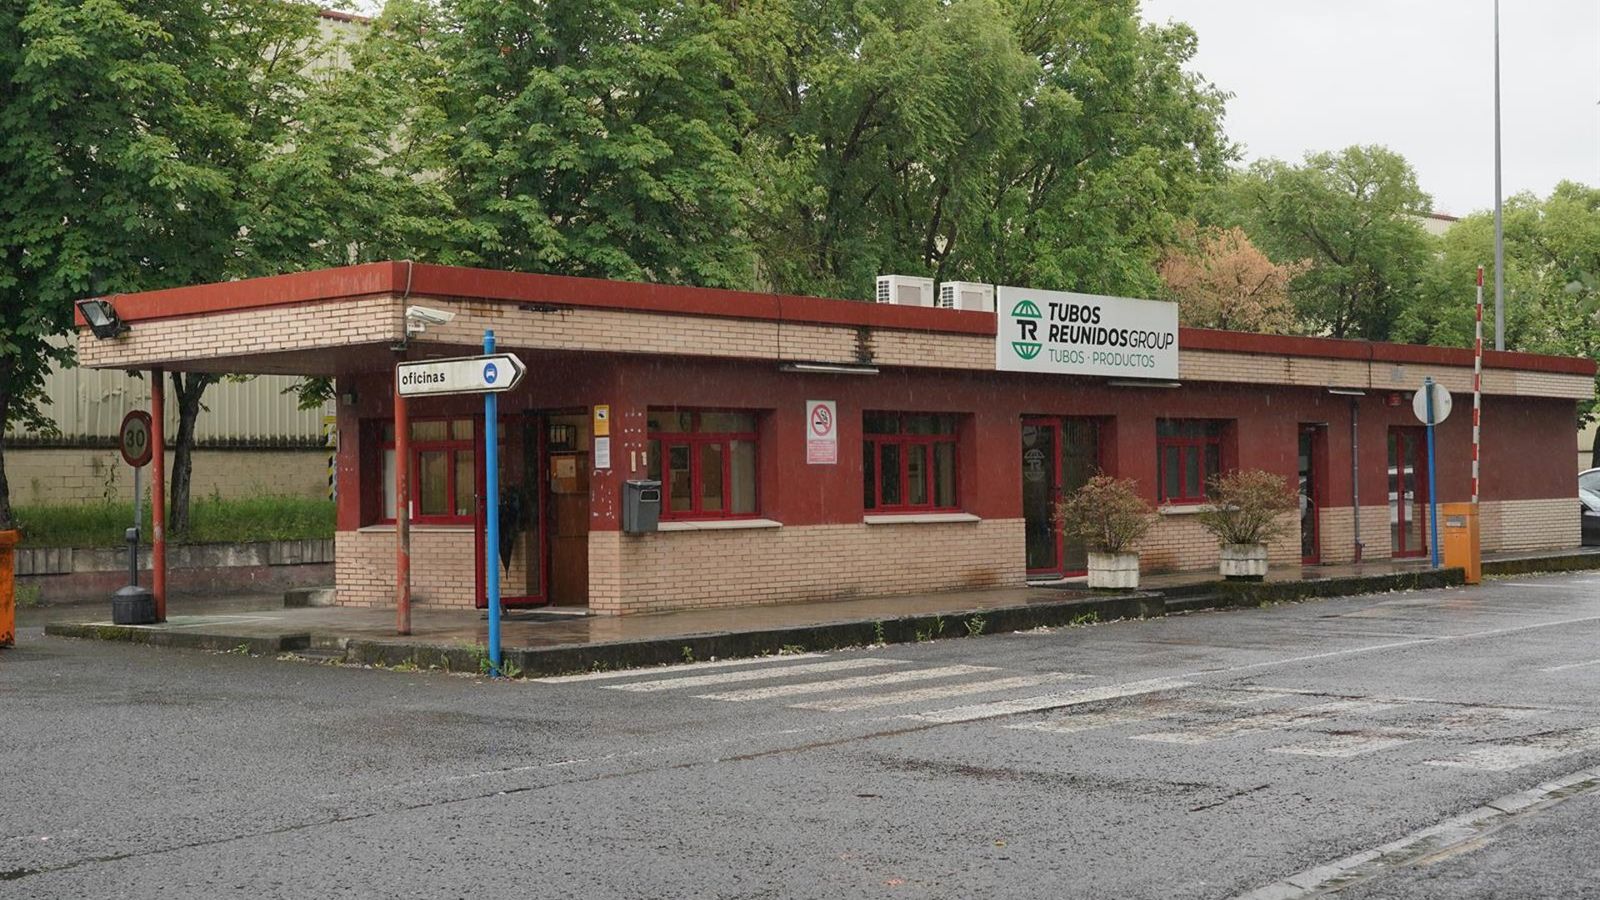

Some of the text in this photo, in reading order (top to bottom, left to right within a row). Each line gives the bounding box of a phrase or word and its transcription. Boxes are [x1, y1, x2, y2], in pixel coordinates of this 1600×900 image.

[1048, 302, 1101, 325] TUBOS
[1016, 319, 1038, 341] TR
[1049, 349, 1155, 368] TUBOS PRODUCTOS
[402, 371, 446, 386] oficinas
[126, 430, 145, 448] 30
